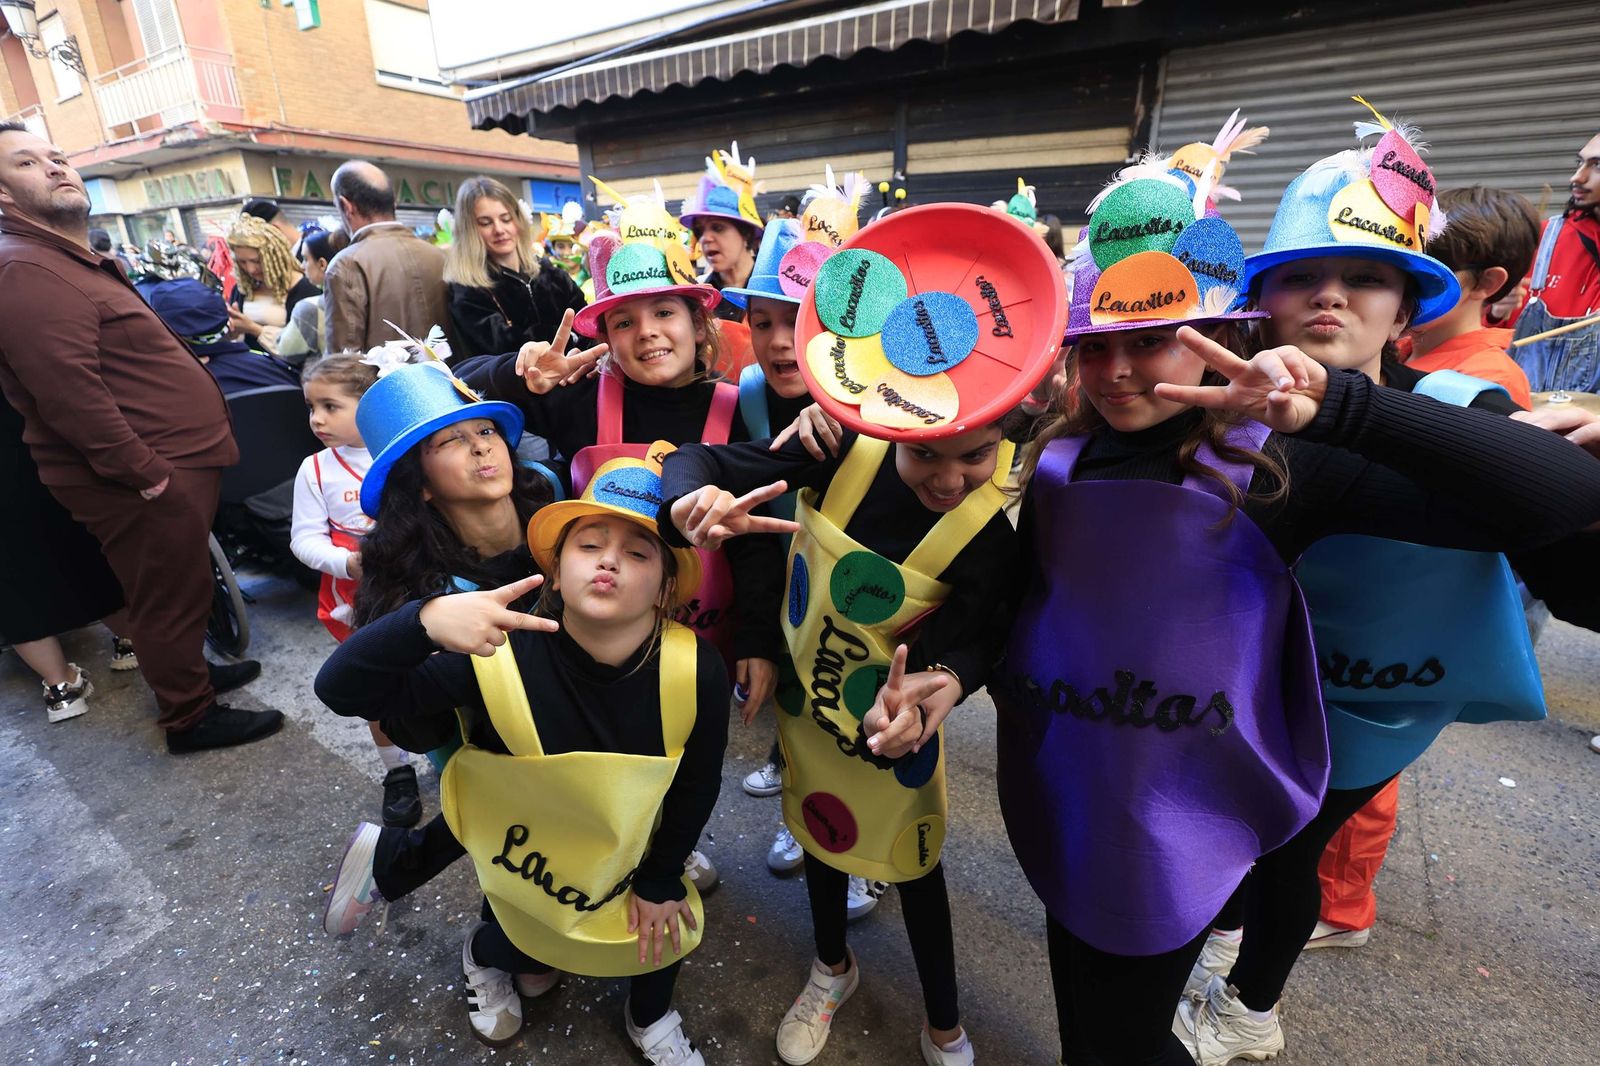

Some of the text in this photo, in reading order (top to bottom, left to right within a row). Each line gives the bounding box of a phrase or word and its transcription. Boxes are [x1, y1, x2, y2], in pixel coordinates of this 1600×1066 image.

[1092, 216, 1184, 243] Lacasitos
[1334, 207, 1414, 247] Lacasitos
[839, 259, 871, 333] Lacasitos
[1094, 288, 1186, 313] Lacasitos
[877, 382, 946, 425] Lacasitos
[600, 481, 663, 506] Lacasito
